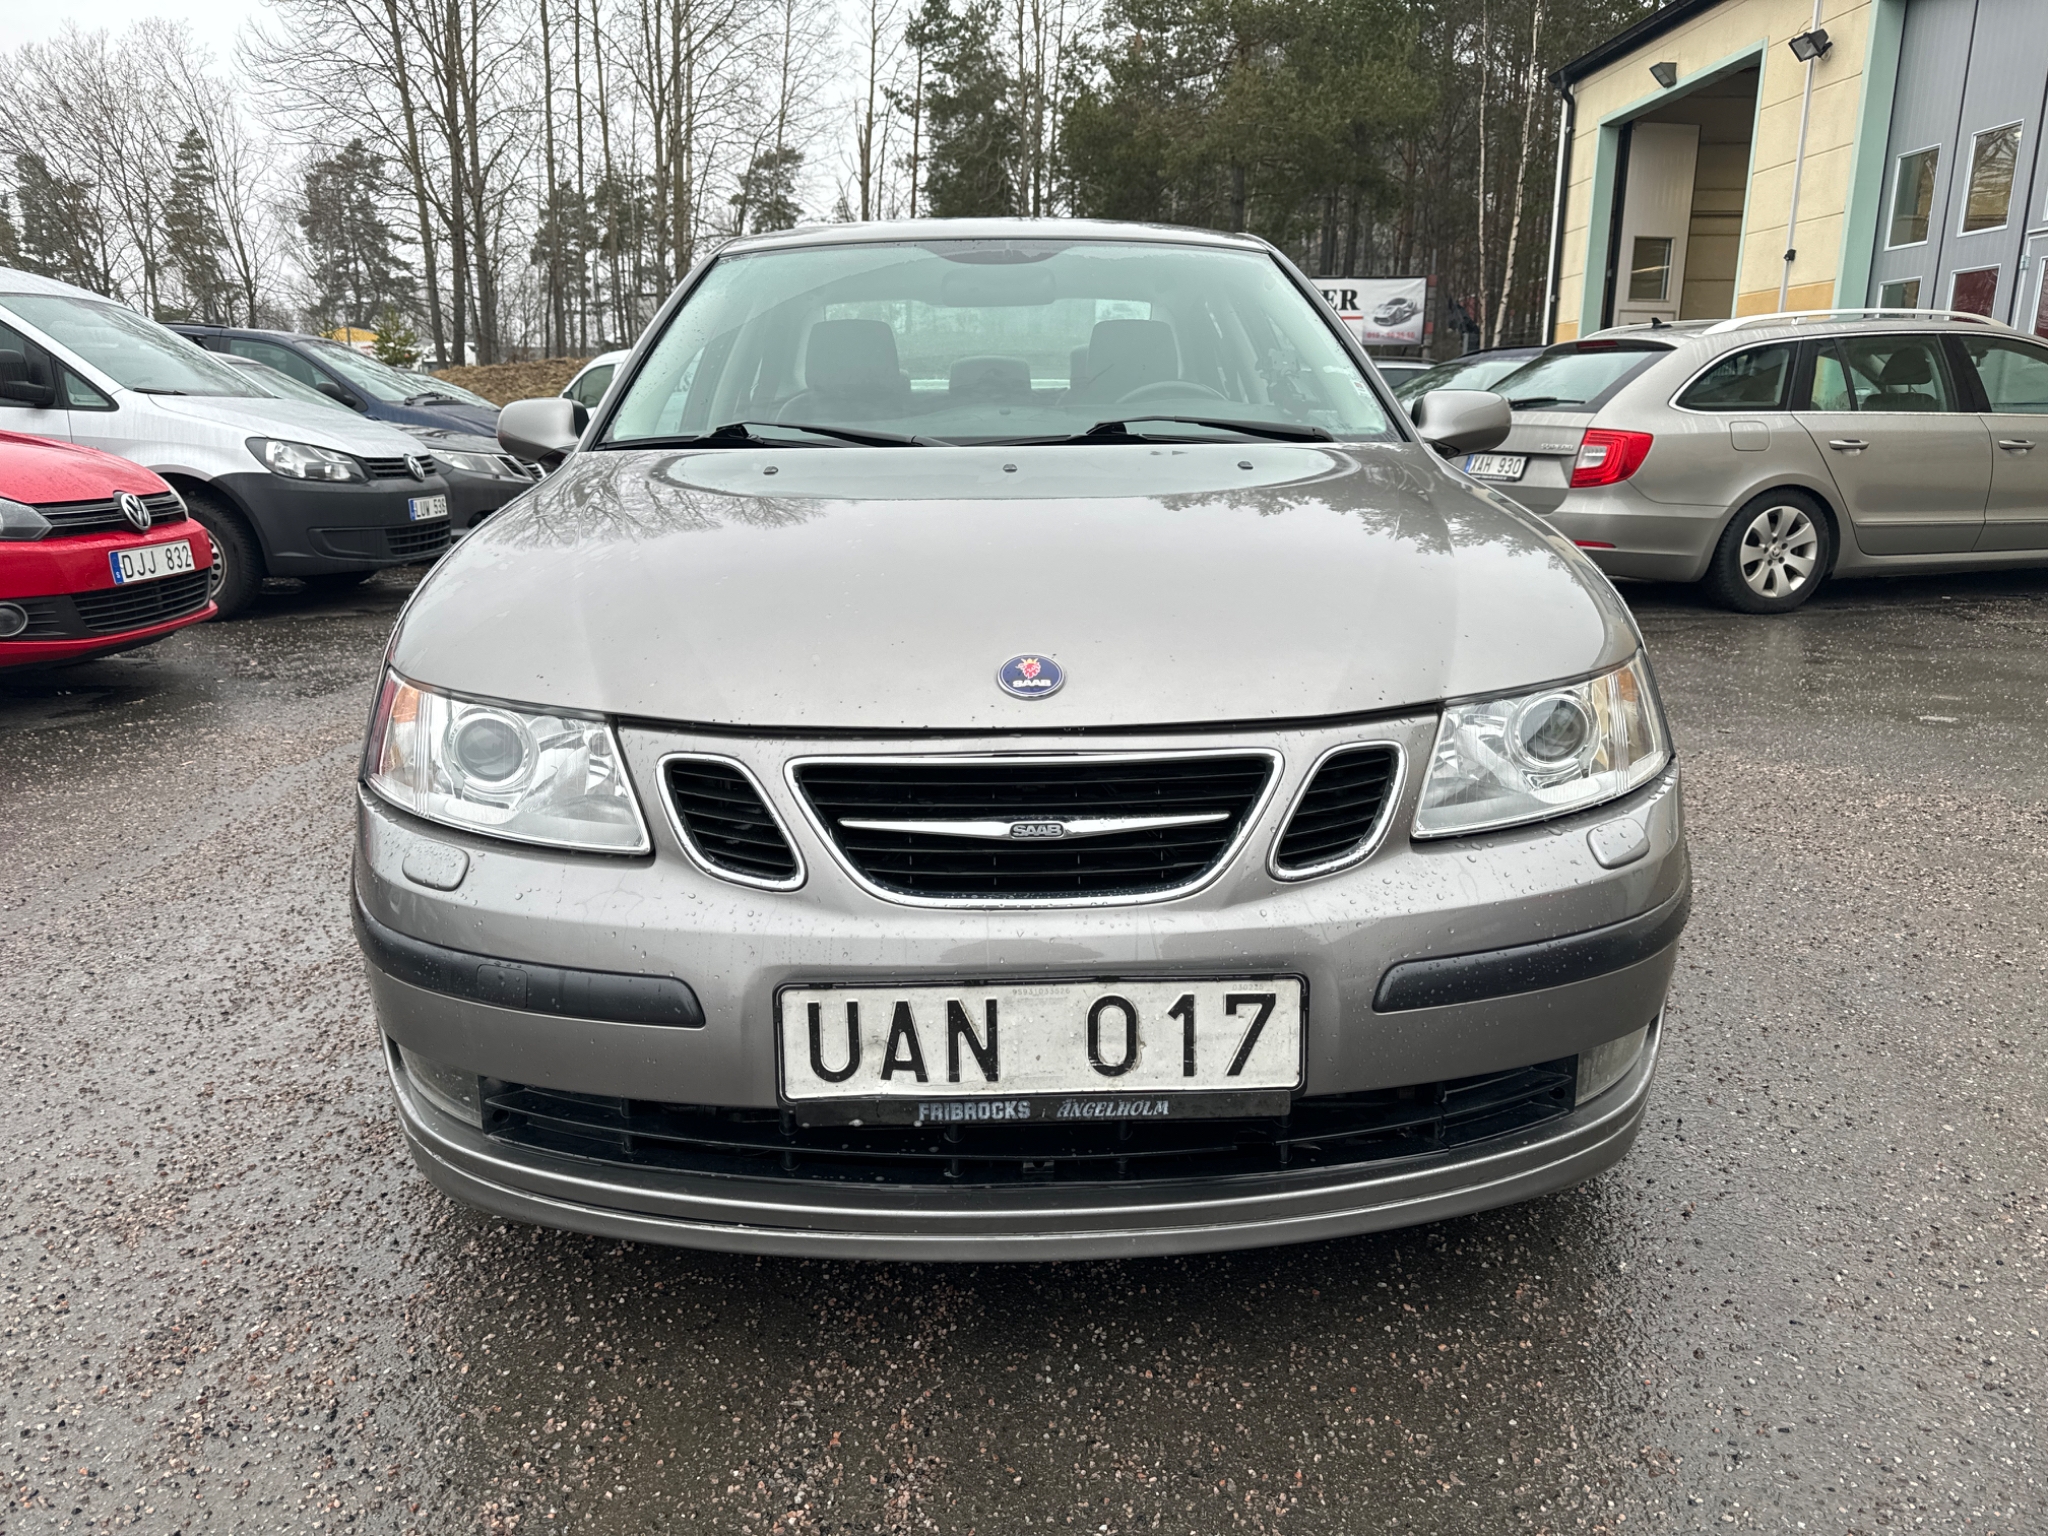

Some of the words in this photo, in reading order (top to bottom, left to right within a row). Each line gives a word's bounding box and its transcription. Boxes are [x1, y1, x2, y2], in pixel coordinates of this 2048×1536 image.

[1470, 455, 1494, 474] XAH
[1496, 457, 1522, 475] 930
[414, 500, 430, 518] LUW
[121, 551, 157, 579] DJJ
[165, 545, 192, 571] 832
[1012, 679, 1052, 688] SAAB
[1013, 824, 1063, 837] SAAB
[807, 998, 999, 1083] UAN
[1087, 992, 1277, 1078] 017
[918, 1100, 1031, 1121] FRIBROCKS
